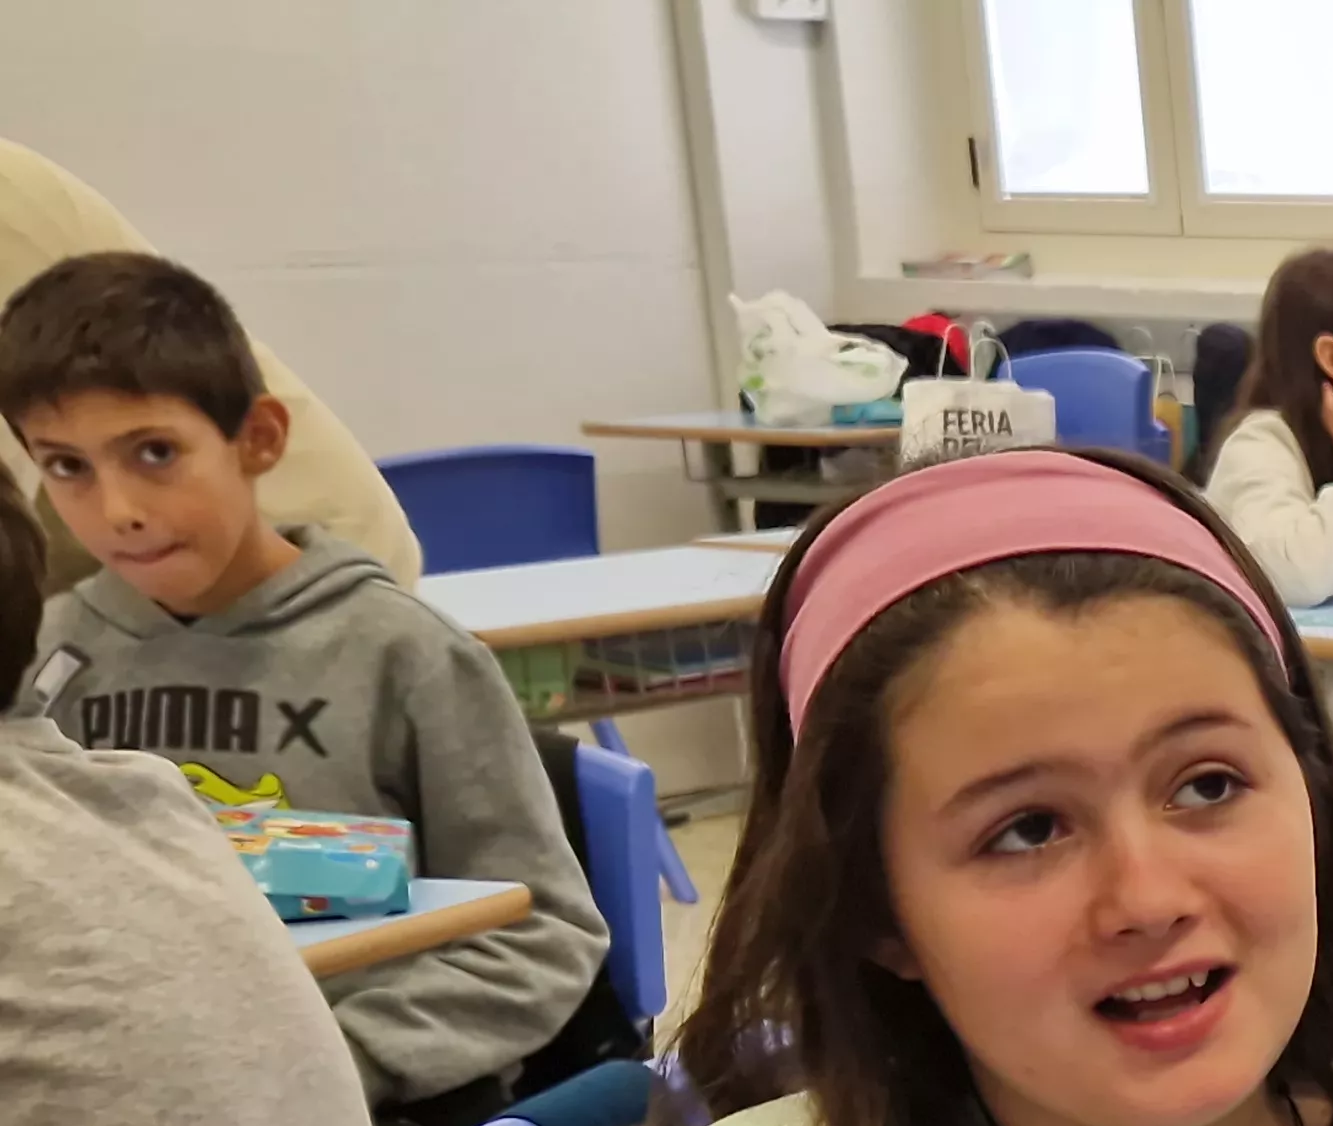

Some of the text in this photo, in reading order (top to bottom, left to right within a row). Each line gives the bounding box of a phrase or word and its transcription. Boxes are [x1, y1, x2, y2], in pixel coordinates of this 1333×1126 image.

[942, 409, 1013, 436] FERIA
[82, 686, 330, 758] PUMA X
